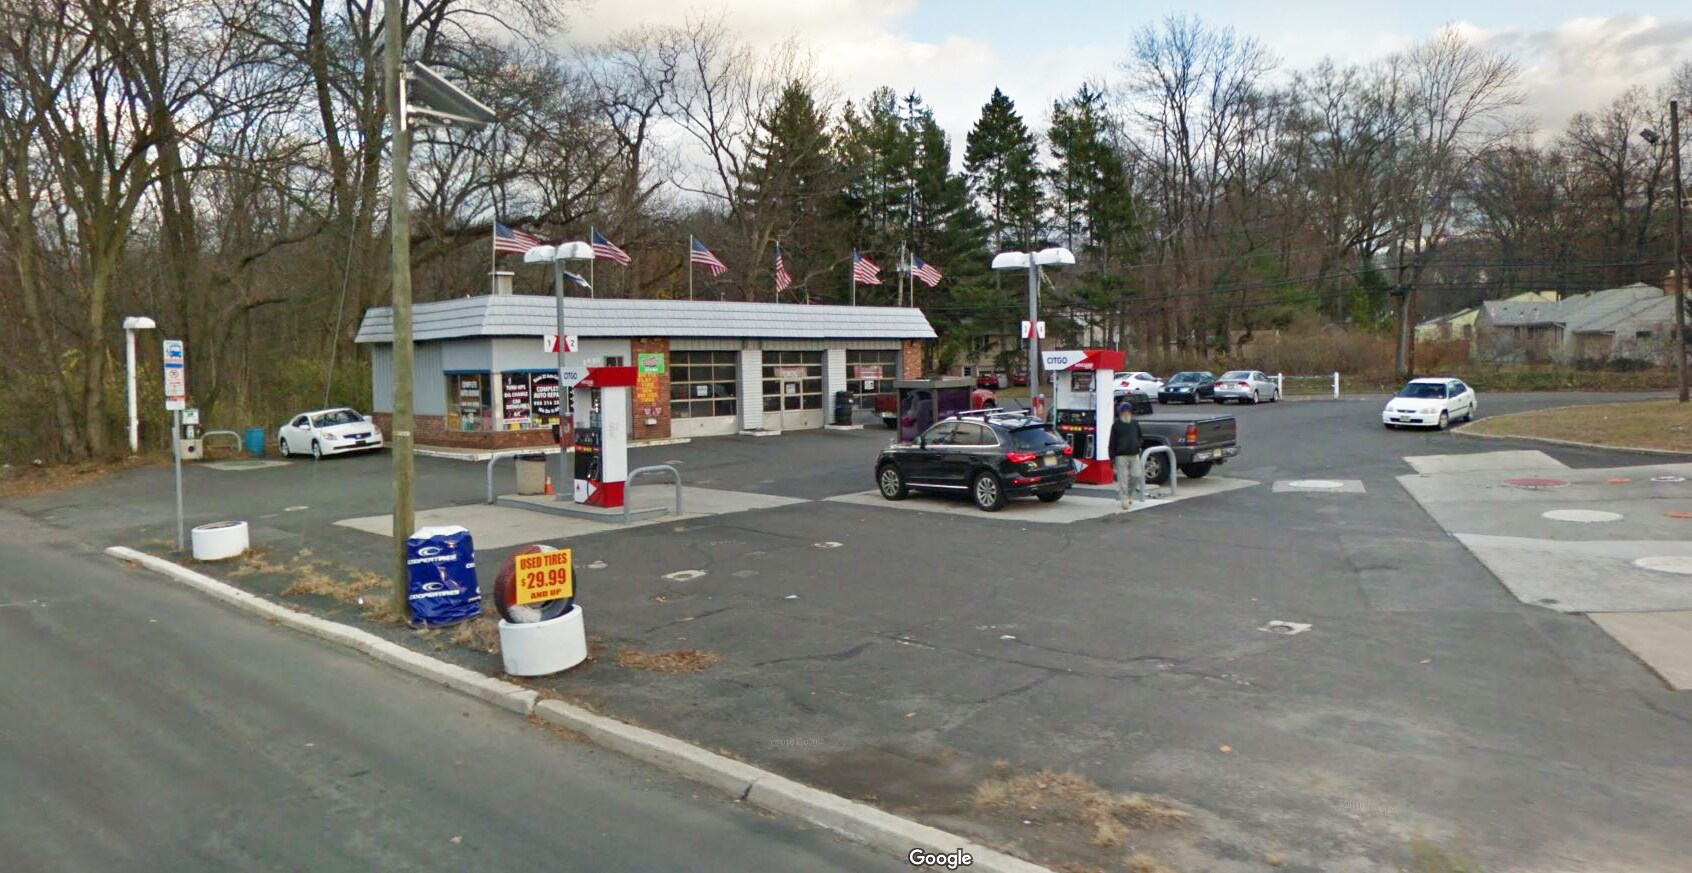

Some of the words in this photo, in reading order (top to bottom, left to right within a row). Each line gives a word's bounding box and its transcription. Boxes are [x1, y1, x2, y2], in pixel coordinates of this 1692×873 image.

[407, 554, 457, 565] COOPERTIRES
[520, 556, 542, 570] USED
[544, 552, 567, 566] TIRES
[409, 589, 460, 600] COOPERTIRES
[530, 590, 548, 599] AND
[550, 588, 562, 596] UP
